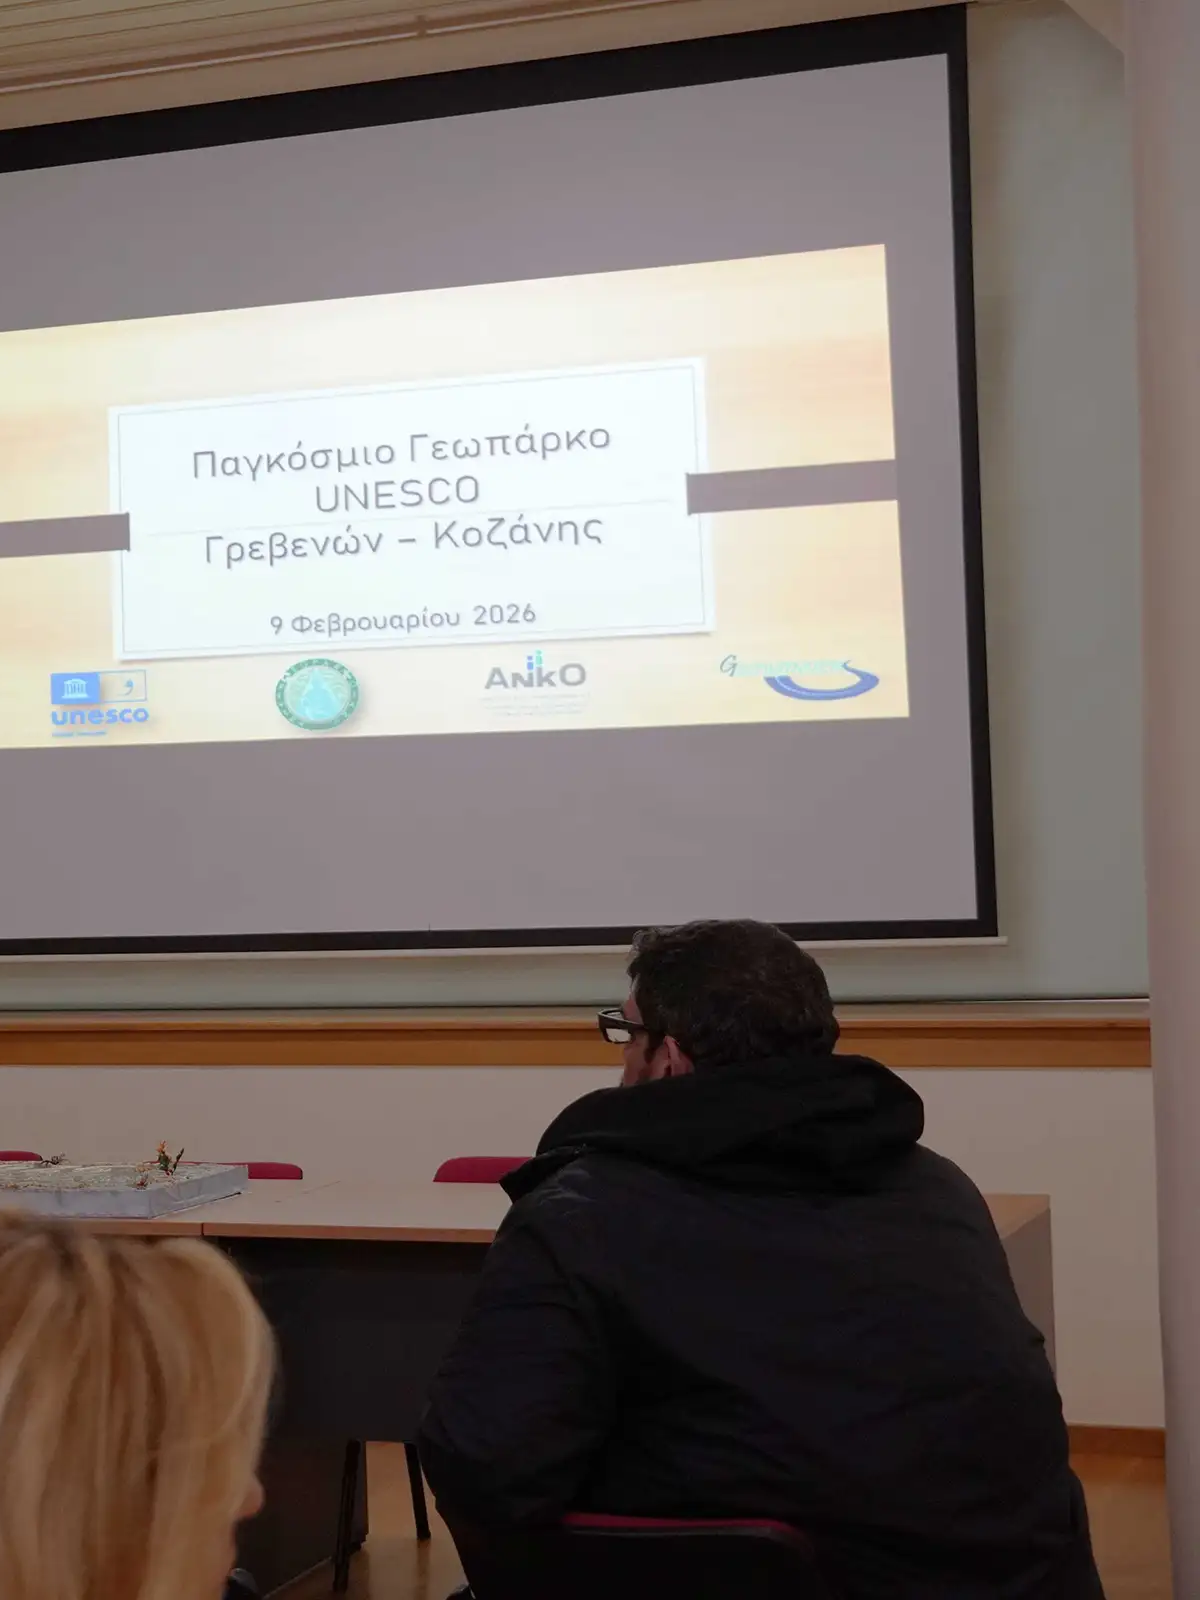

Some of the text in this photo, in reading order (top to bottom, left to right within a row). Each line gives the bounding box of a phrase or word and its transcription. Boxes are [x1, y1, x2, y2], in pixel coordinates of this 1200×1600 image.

[192, 423, 612, 481] Παγκόσμιο Γεωπάρκο
[315, 474, 481, 513] UNESCO
[205, 524, 384, 570] Γρεβενών
[434, 513, 604, 550] Κοζάνης
[270, 603, 537, 636] 9 Φεβρουαρίου 2026
[50, 707, 149, 726] unesco
